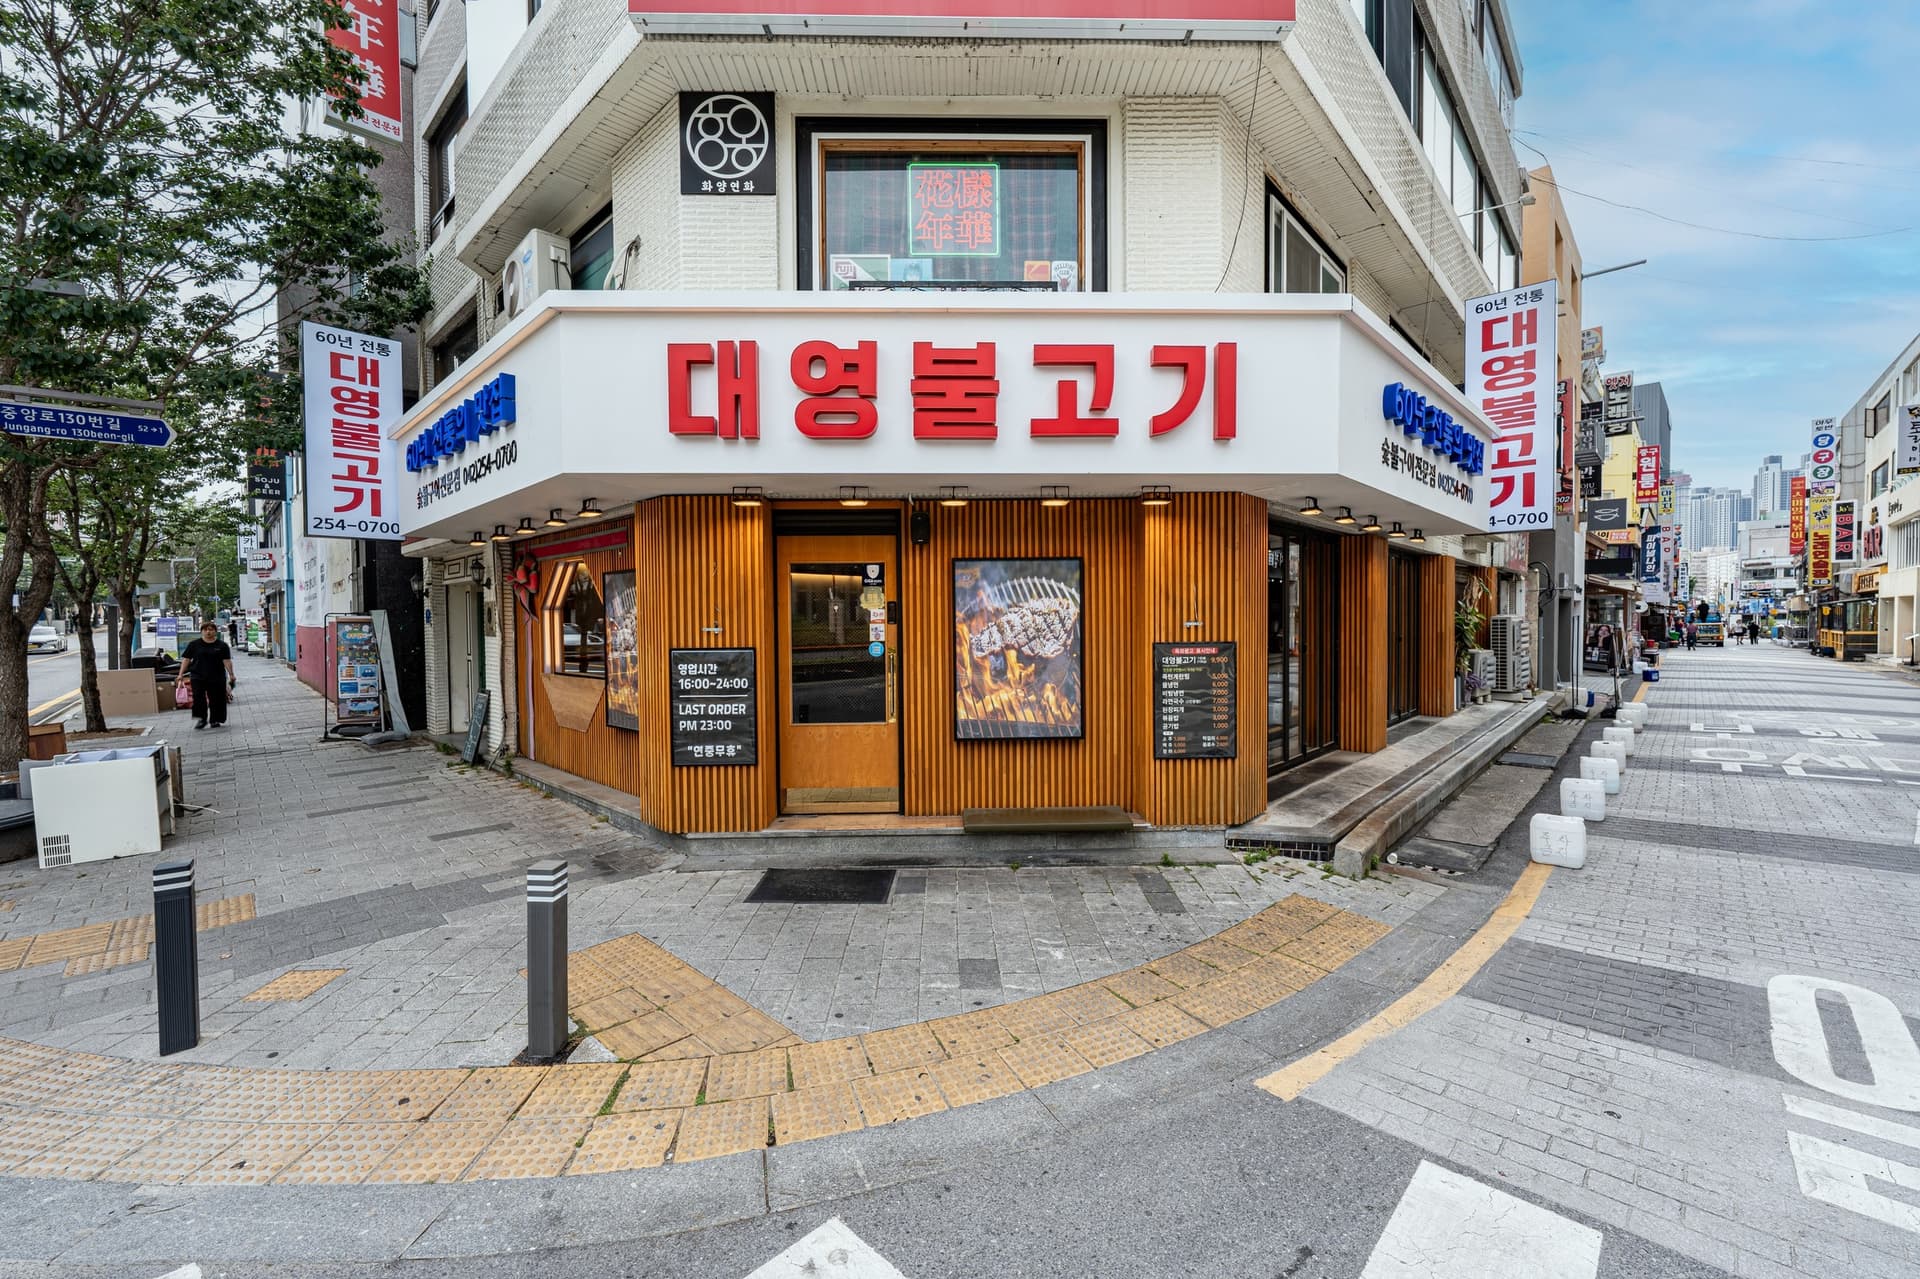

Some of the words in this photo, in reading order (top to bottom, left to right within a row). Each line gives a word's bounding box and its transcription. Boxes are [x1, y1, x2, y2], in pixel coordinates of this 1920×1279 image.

[701, 180, 755, 193] 화양연화
[1475, 298, 1508, 314] 60년
[1514, 288, 1545, 306] 전통
[315, 331, 353, 349] 60년
[359, 338, 392, 357] 전통
[667, 340, 1237, 441] 대영불고기
[3, 421, 68, 436] Jungang-ro
[72, 428, 135, 442] 130beon-gil
[329, 351, 382, 517] 대영불고기
[1638, 457, 1657, 489] 원룸
[313, 517, 400, 534] 254-0700
[1836, 514, 1853, 553] BAR
[1864, 525, 1883, 560] BAR
[678, 663, 719, 675] 영업시간
[1162, 656, 1196, 664] 대영불고기
[678, 678, 749, 690] 16:00~24:00
[679, 704, 706, 715] LAST
[708, 704, 746, 715] ORDER
[679, 720, 697, 731] PM
[700, 720, 732, 731] 23:00
